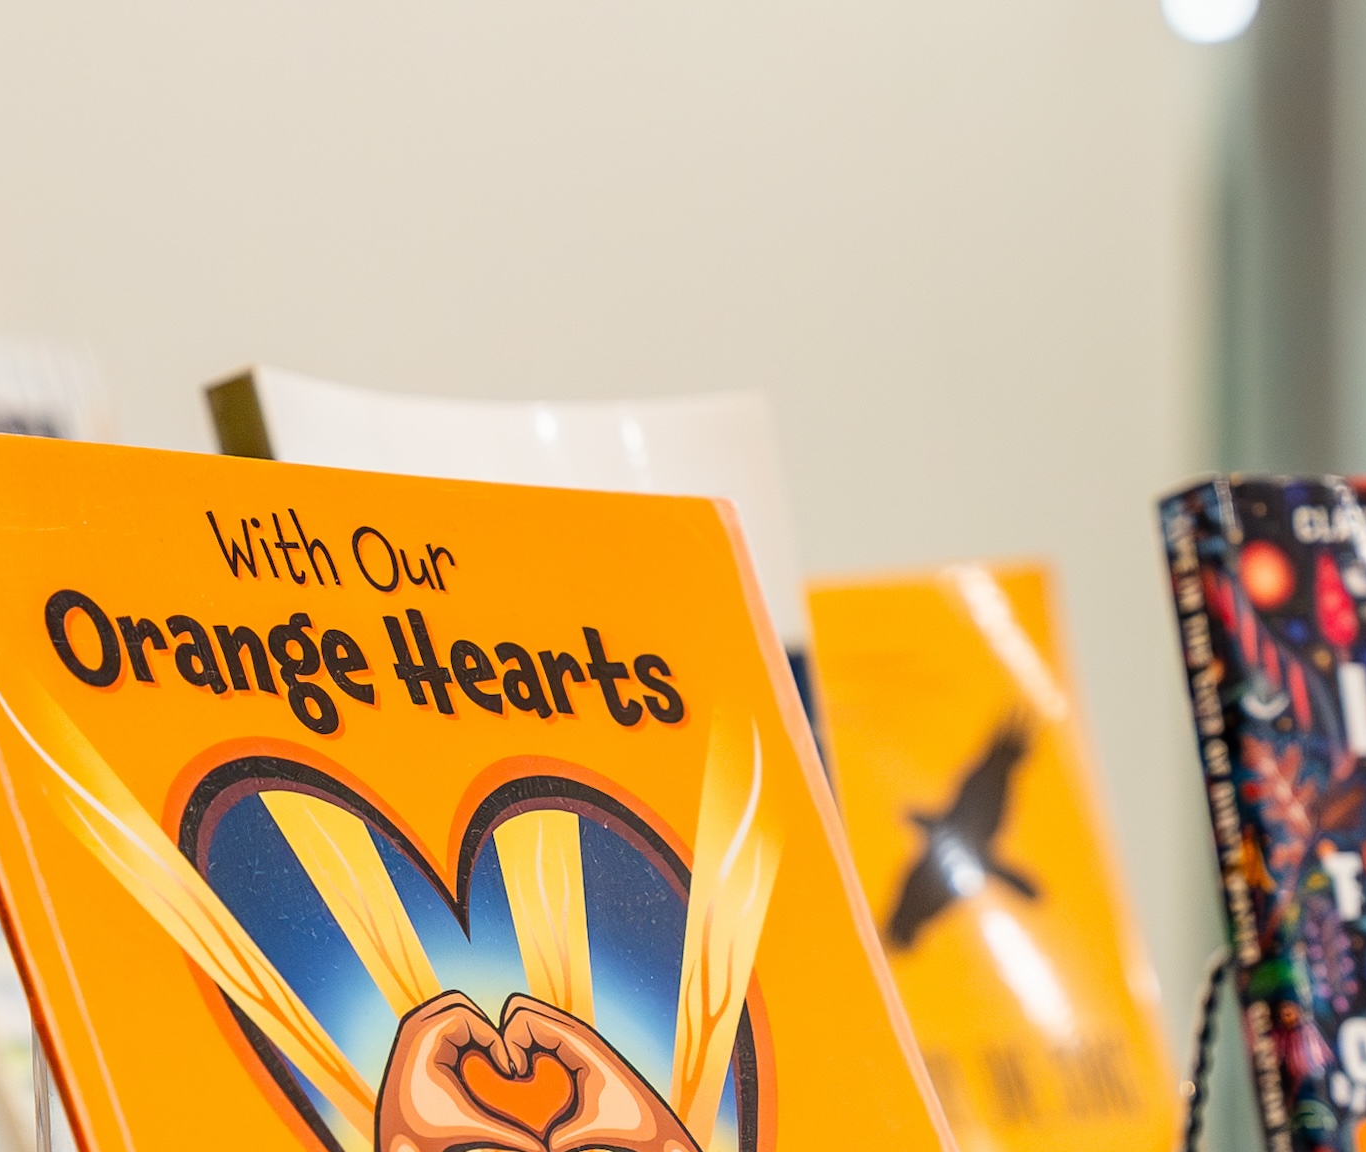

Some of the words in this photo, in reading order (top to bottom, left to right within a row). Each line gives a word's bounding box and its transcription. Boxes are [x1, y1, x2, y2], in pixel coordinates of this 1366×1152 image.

[207, 508, 341, 587] With
[351, 526, 455, 592] Our
[45, 589, 375, 735] Orange
[383, 608, 684, 727] Hearts
